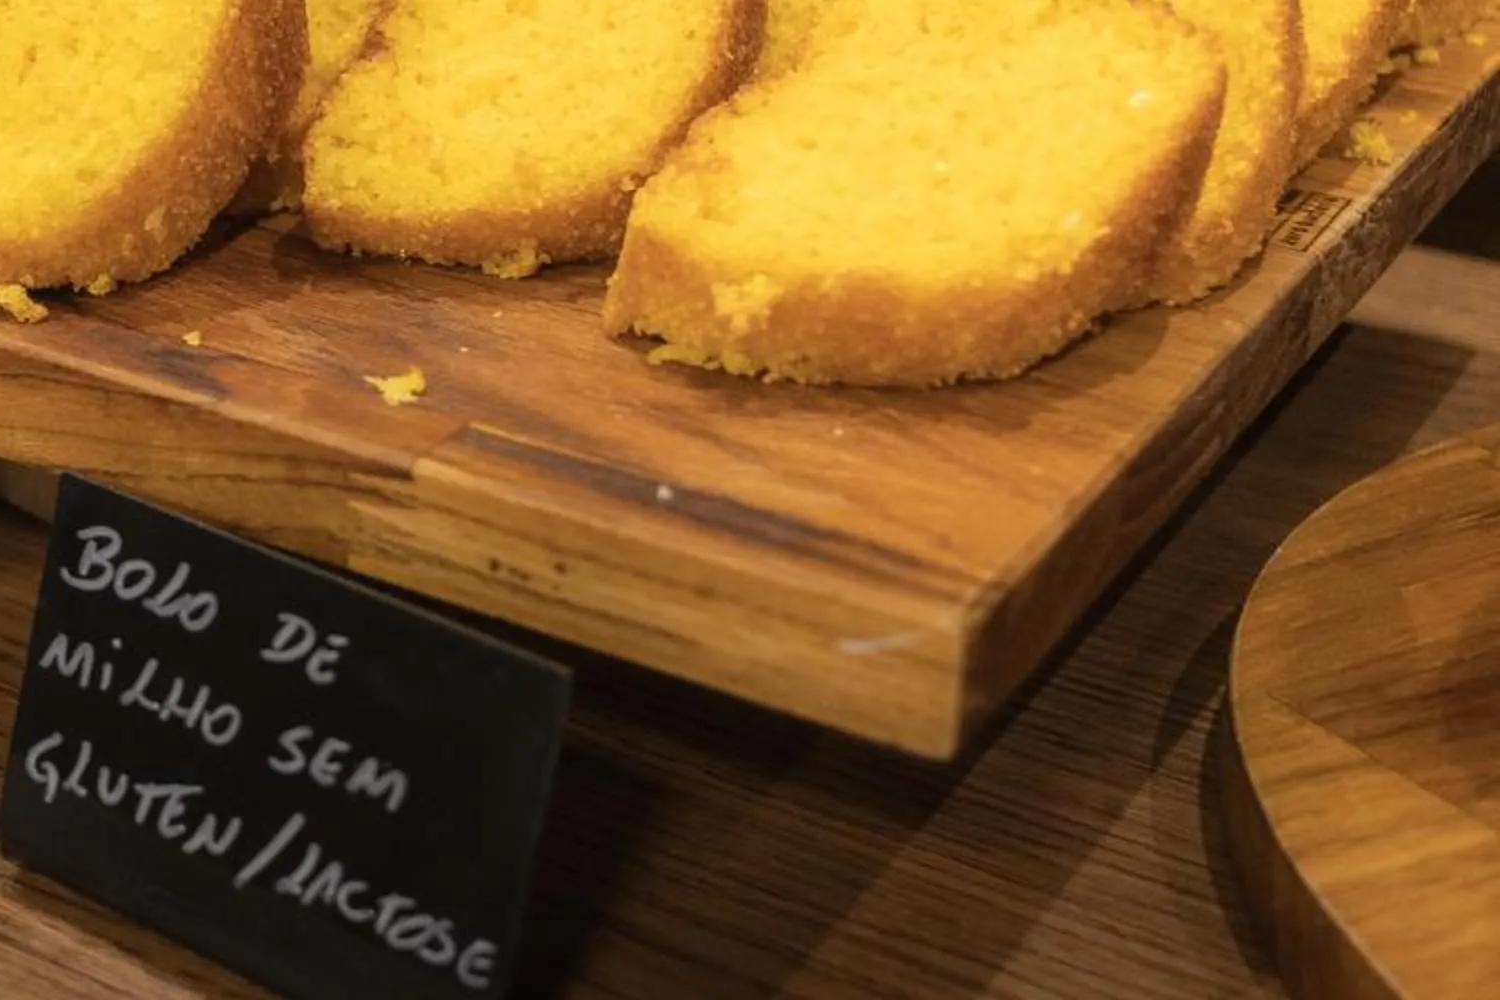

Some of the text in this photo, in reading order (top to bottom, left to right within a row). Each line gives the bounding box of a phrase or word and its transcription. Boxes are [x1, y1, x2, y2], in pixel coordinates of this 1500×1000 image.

[59, 525, 349, 684] BOLO DE
[267, 725, 408, 812] SEM
